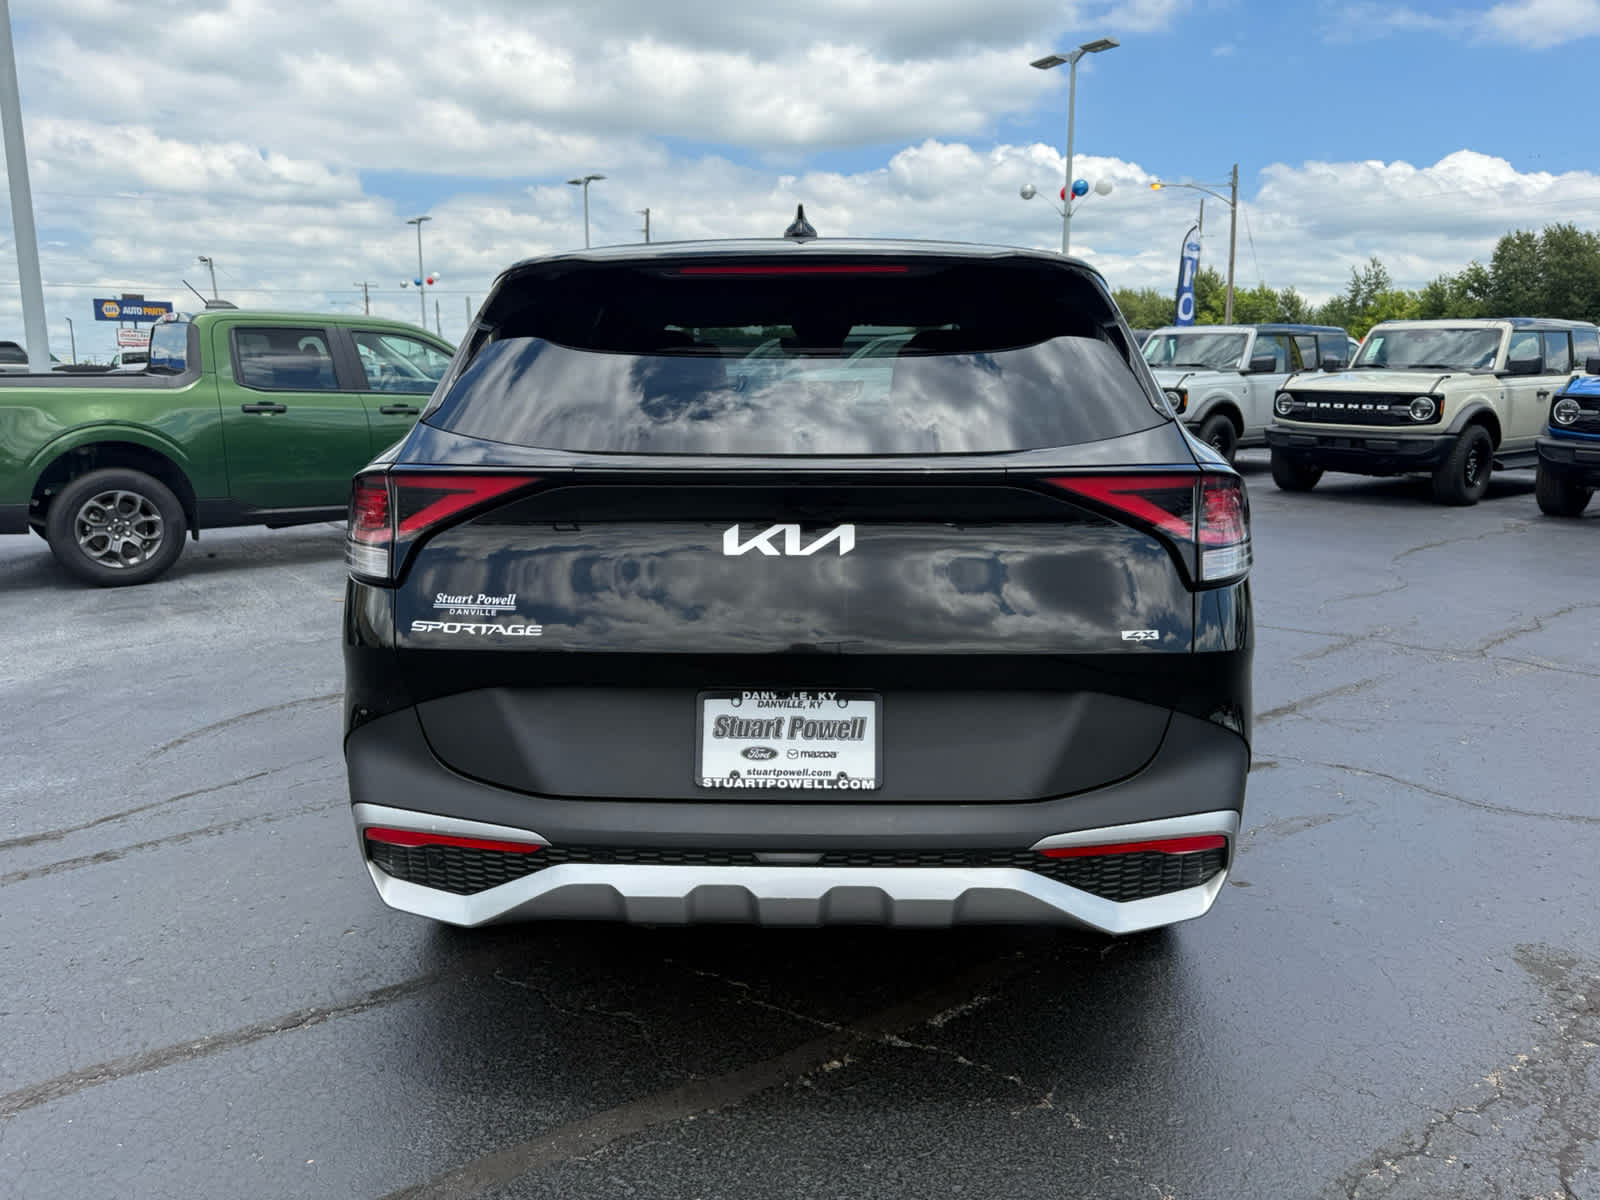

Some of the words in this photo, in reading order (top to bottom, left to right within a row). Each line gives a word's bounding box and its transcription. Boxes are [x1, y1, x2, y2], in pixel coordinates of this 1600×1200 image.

[122, 306, 142, 315] AUTO
[1306, 402, 1389, 410] BRONCO
[723, 523, 855, 556] KIA
[435, 592, 474, 604] Stuart
[476, 593, 517, 605] Powell
[449, 608, 497, 616] DANVILLE
[411, 620, 543, 636] SPORTAGE
[818, 692, 836, 700] KY
[757, 700, 806, 709] DANVILLE,
[809, 700, 824, 709] KY
[712, 715, 785, 739] Stuart
[786, 716, 868, 741] Powell
[745, 746, 773, 760] Ford
[746, 768, 832, 778] stuartpowell.com
[702, 778, 876, 790] STUARTPOWELL.COM
